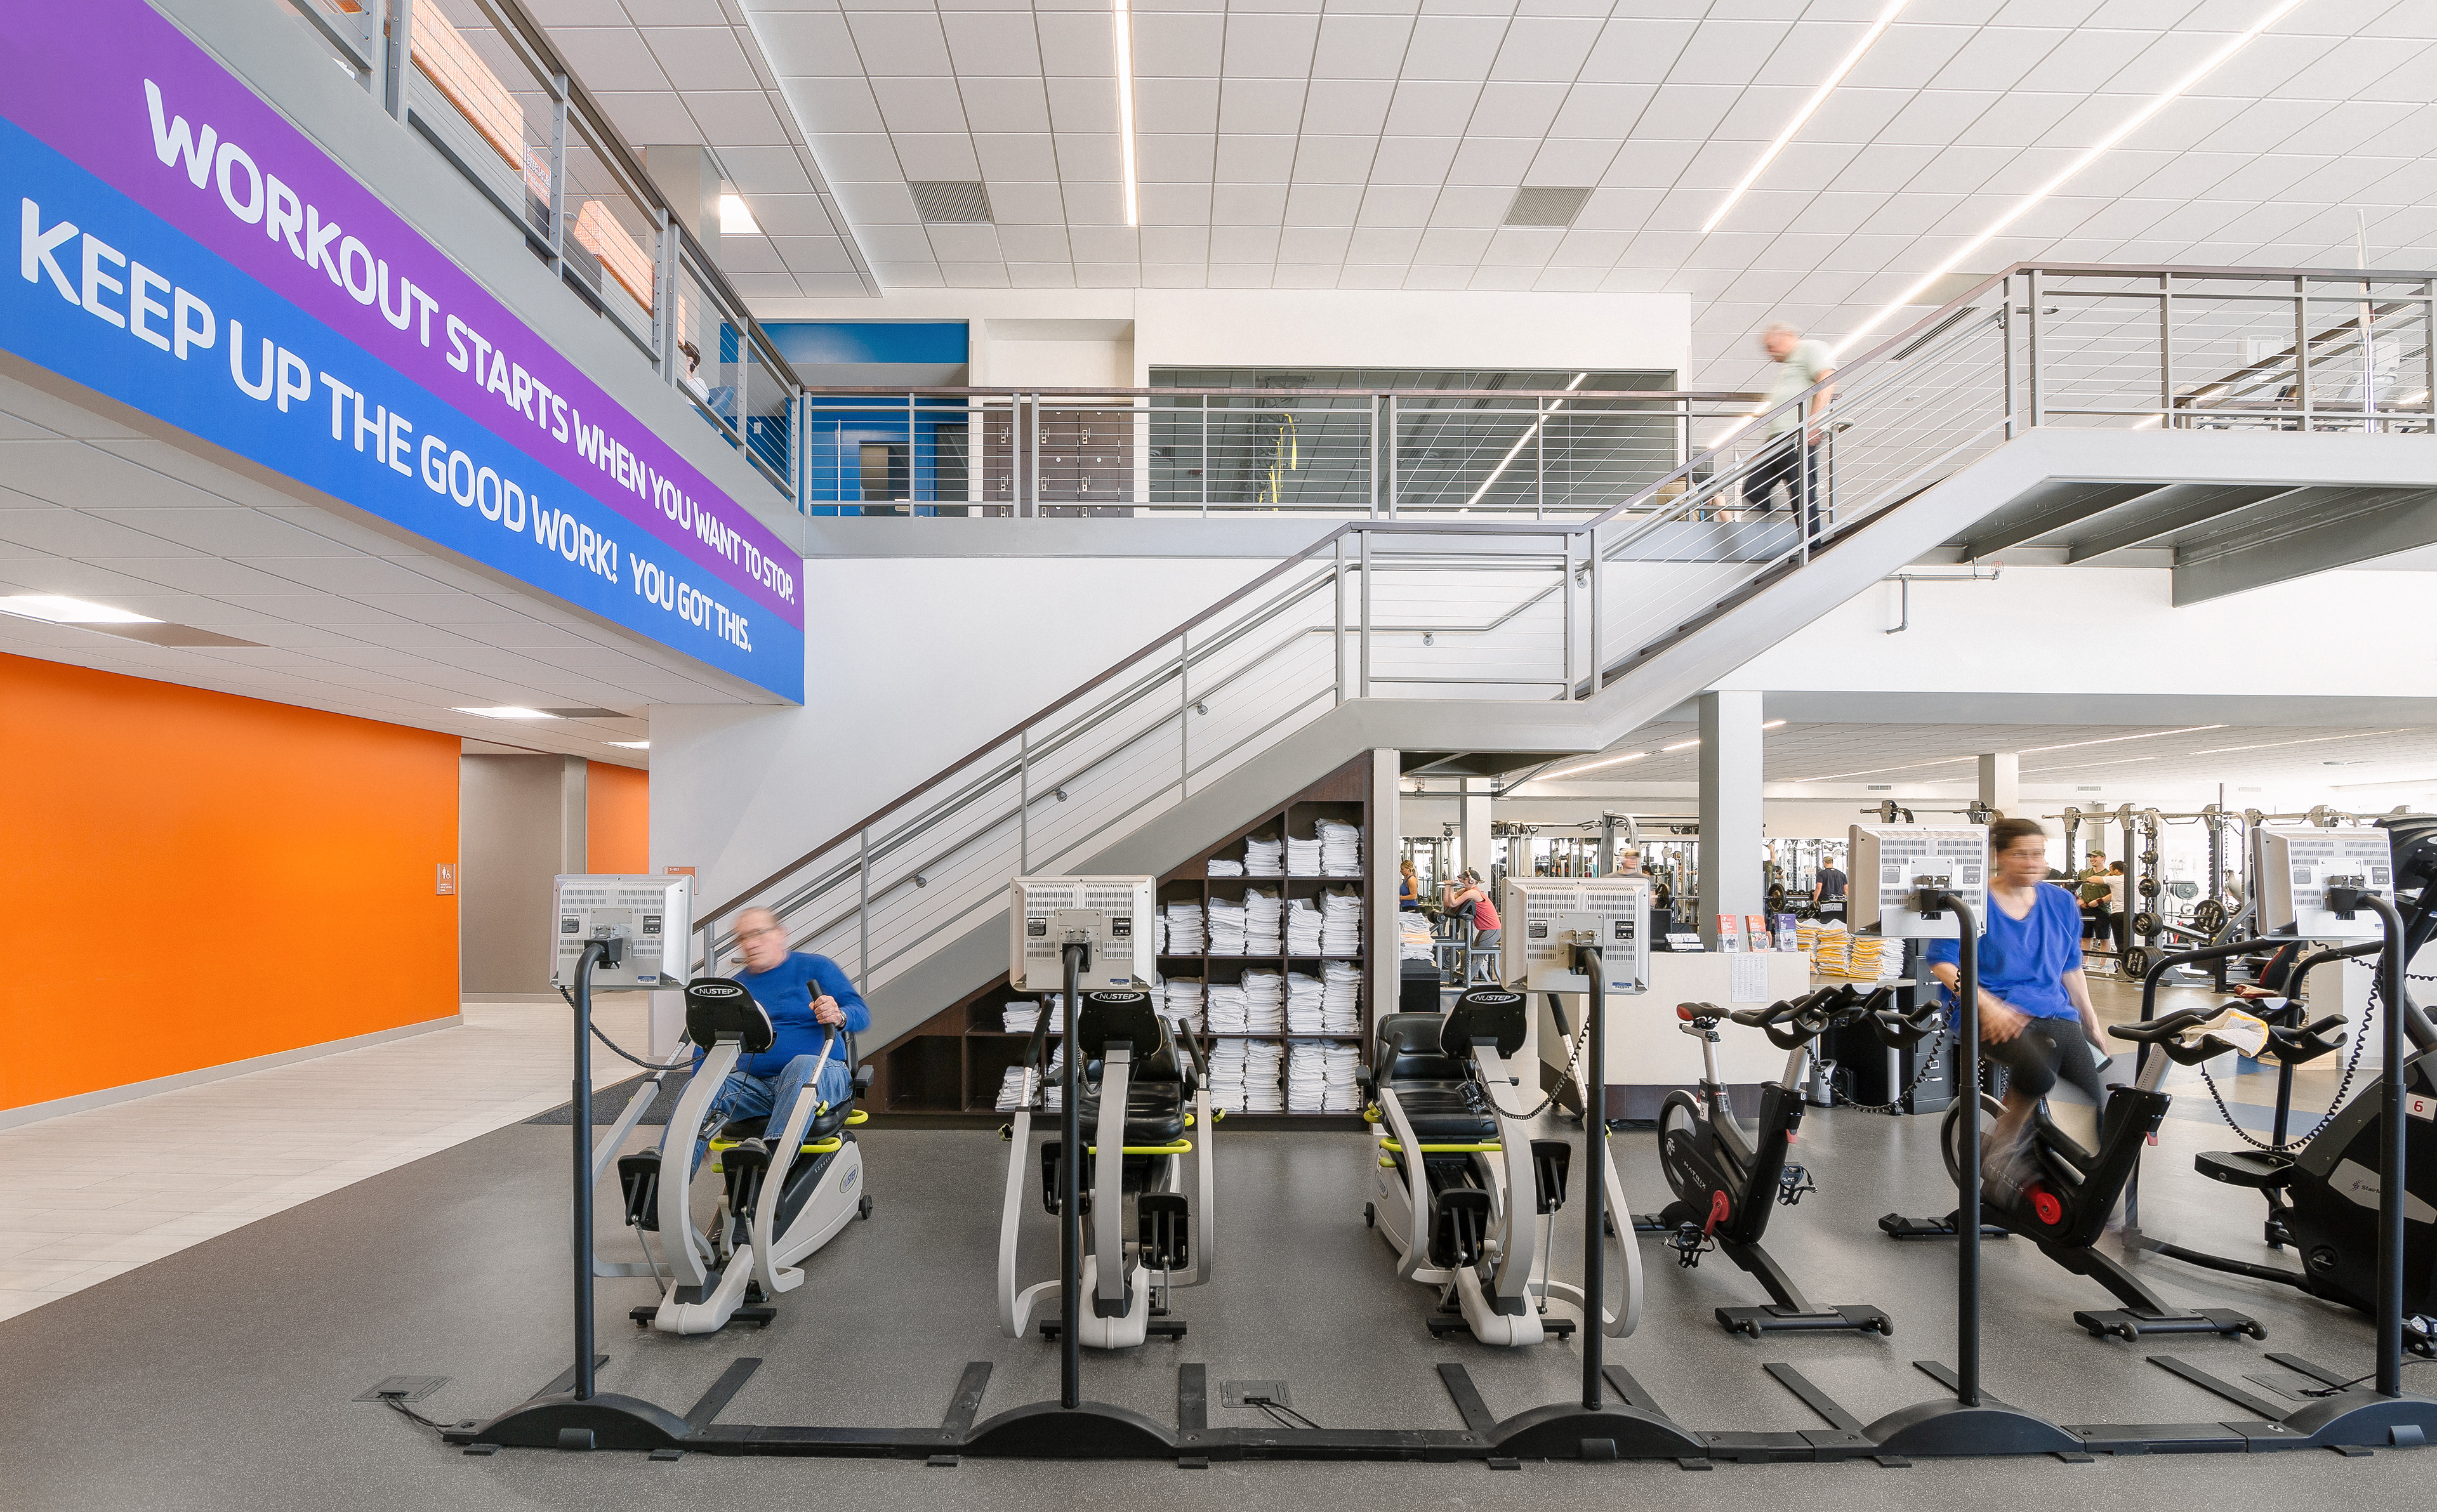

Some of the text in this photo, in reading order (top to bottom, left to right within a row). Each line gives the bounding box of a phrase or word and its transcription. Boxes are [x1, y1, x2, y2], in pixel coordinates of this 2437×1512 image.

[144, 79, 795, 606] WORKOUT STARTS WHEN YOU WANT TO STOP.
[21, 197, 753, 654] KEEP UP THE GOOD WORK! YOU GOT THIS.
[2414, 1100, 2424, 1113] 6
[1684, 1160, 1707, 1190] MATRIX
[1989, 1163, 2024, 1193] MATRIX
